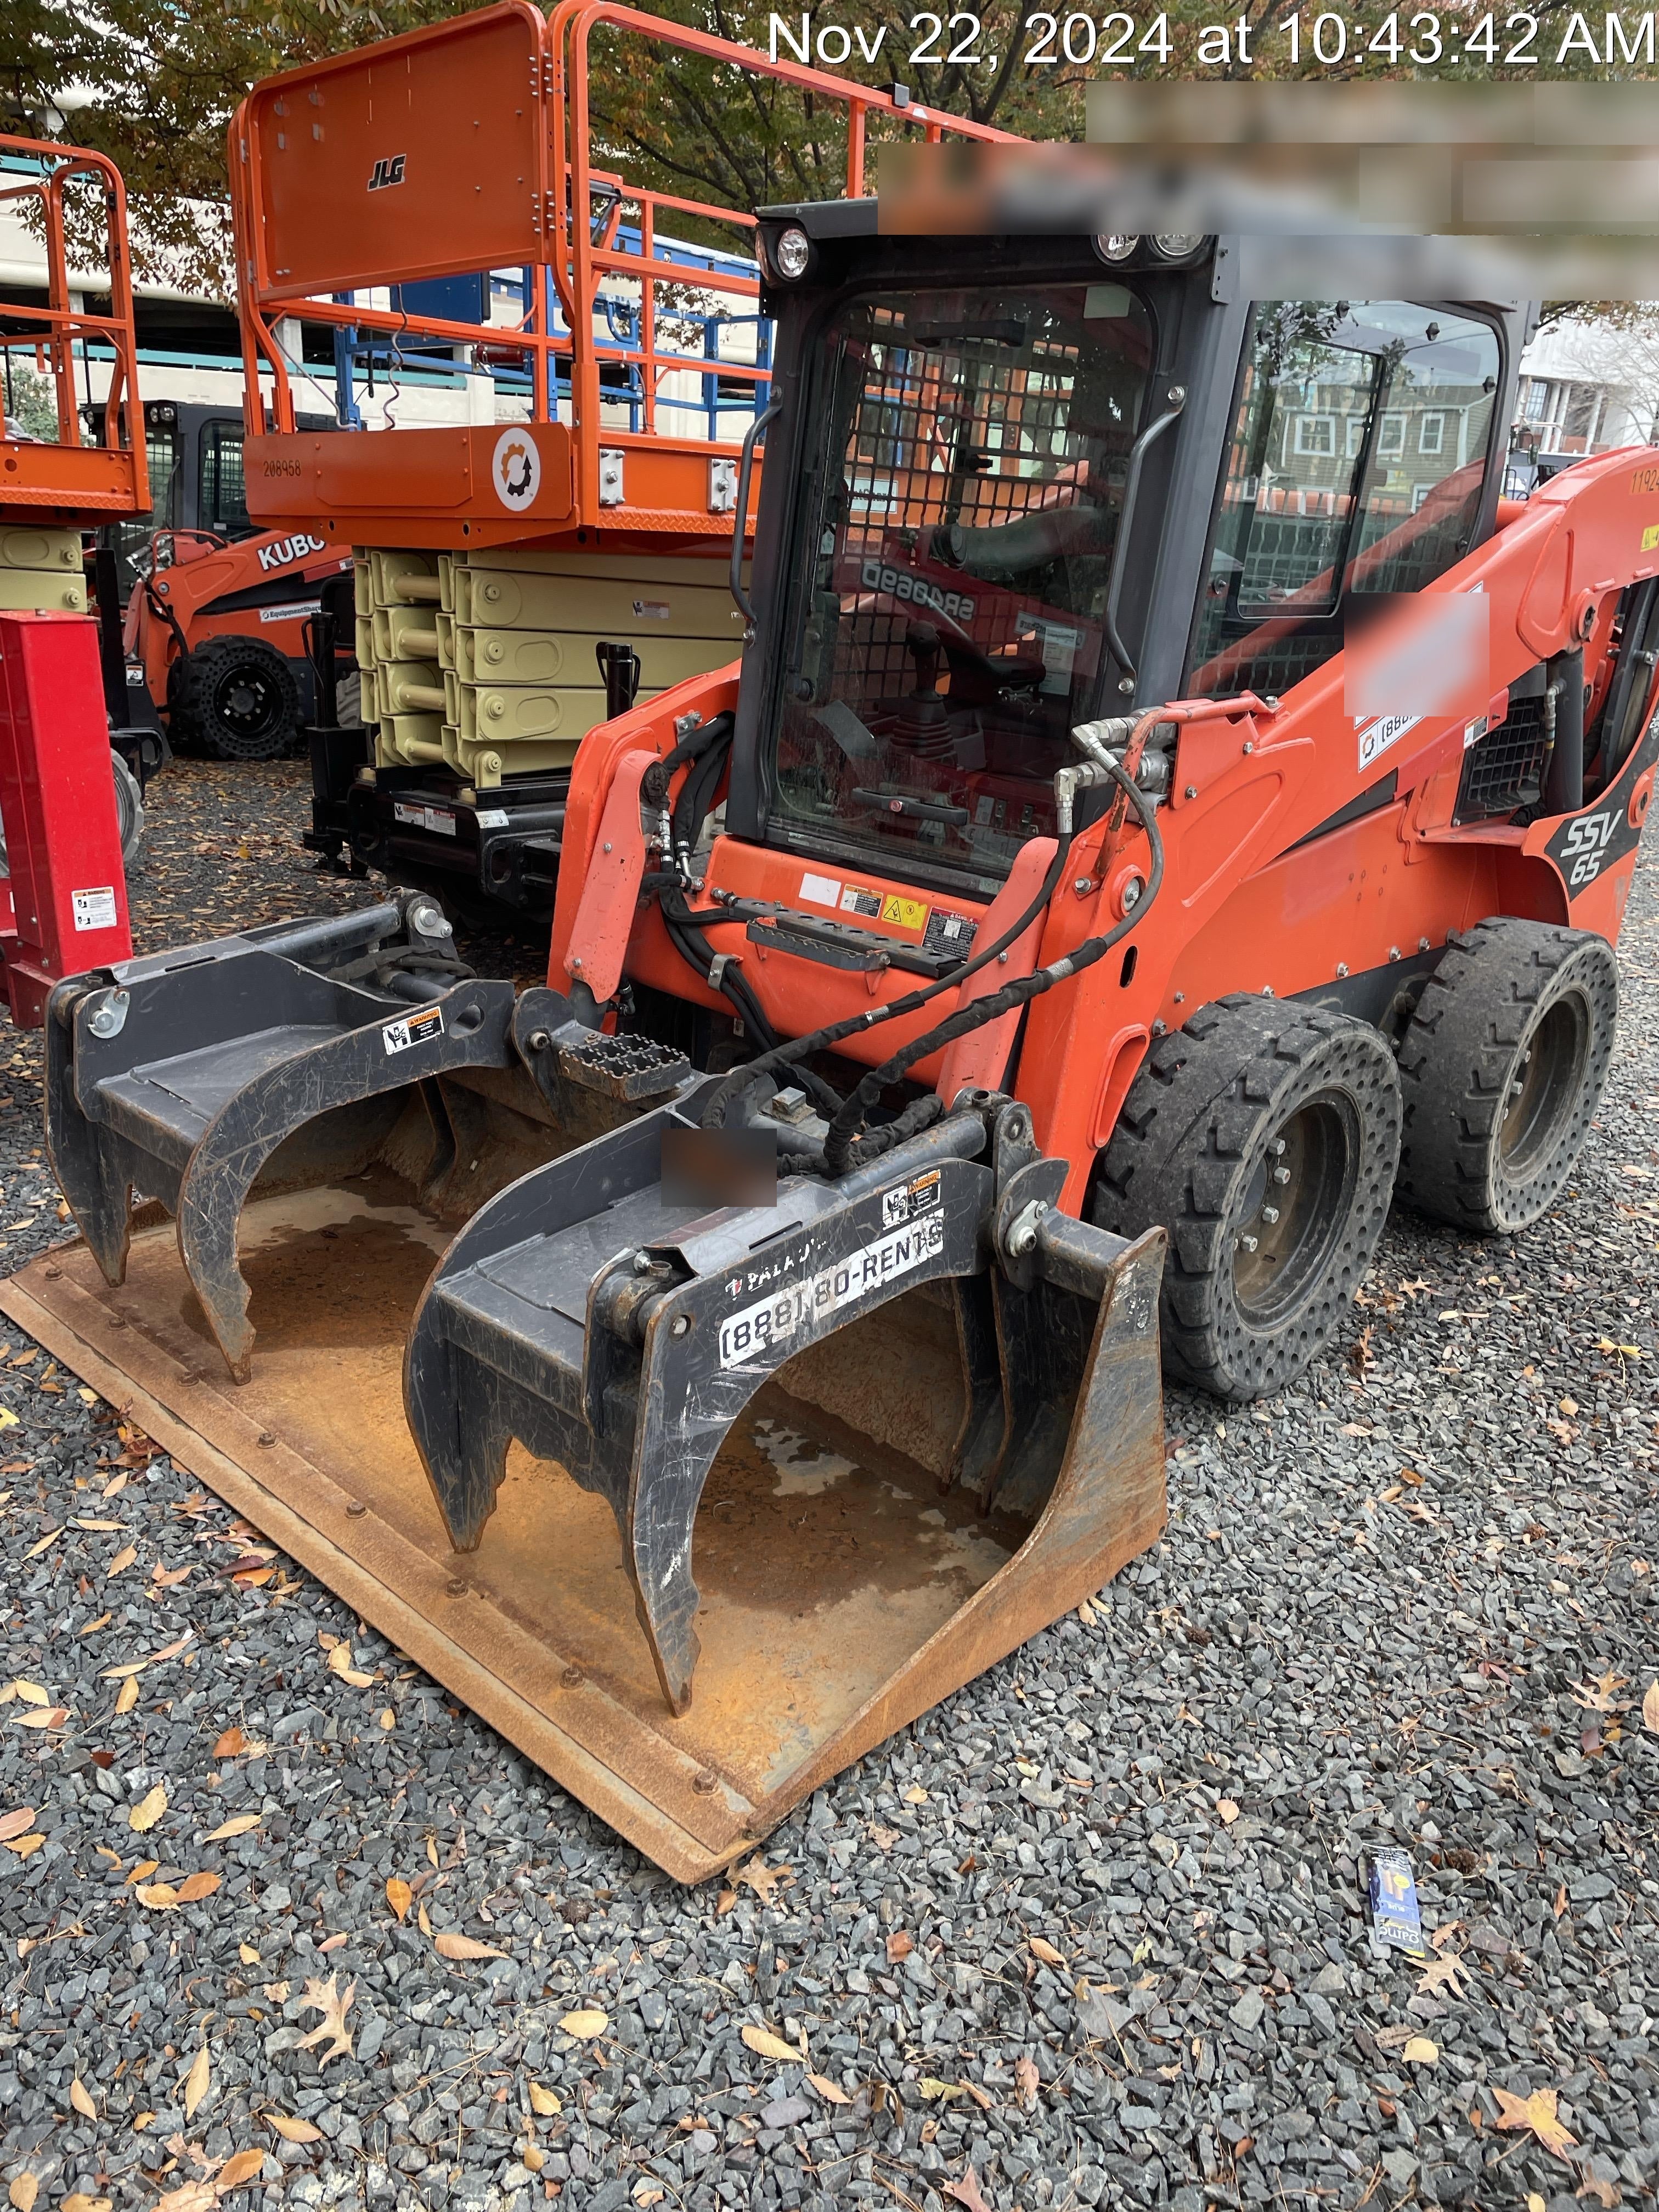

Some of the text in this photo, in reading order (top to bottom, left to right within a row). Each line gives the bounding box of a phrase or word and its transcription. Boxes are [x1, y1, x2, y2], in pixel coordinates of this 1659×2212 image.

[368, 155, 406, 190] JLG
[263, 460, 301, 477] 208958
[1560, 808, 1624, 857] SSV
[1570, 849, 1605, 885] 65
